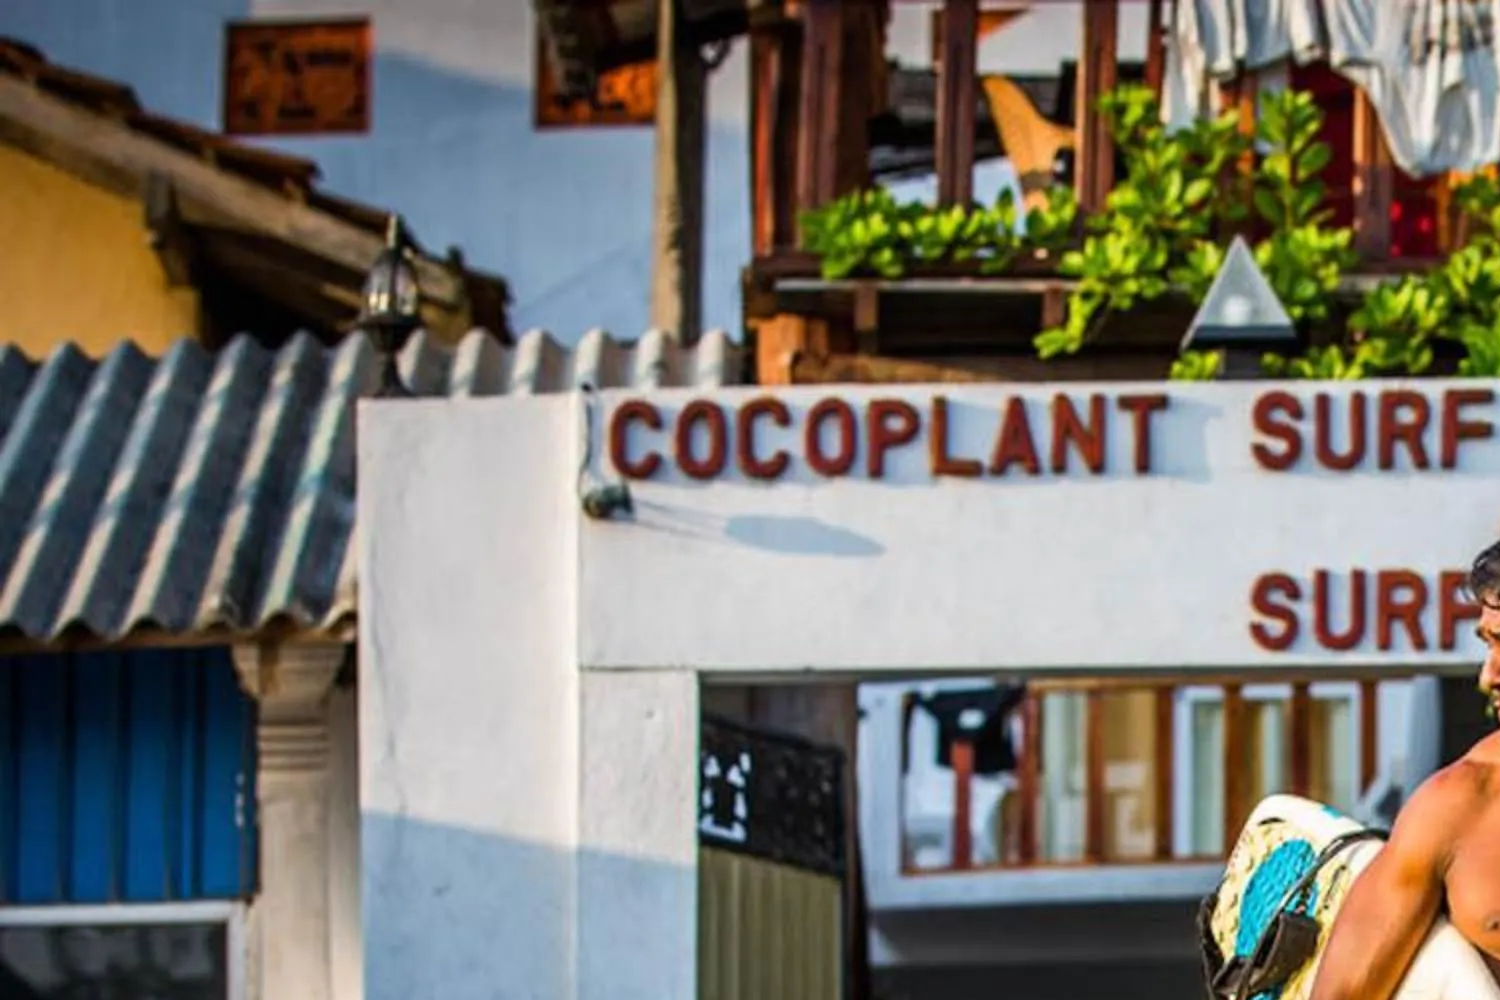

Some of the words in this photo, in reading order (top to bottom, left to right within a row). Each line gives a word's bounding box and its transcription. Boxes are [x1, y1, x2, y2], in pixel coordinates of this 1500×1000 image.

[608, 393, 1169, 480] COCOPLANT
[1251, 389, 1494, 471] SURF
[1250, 569, 1480, 651] SURF
